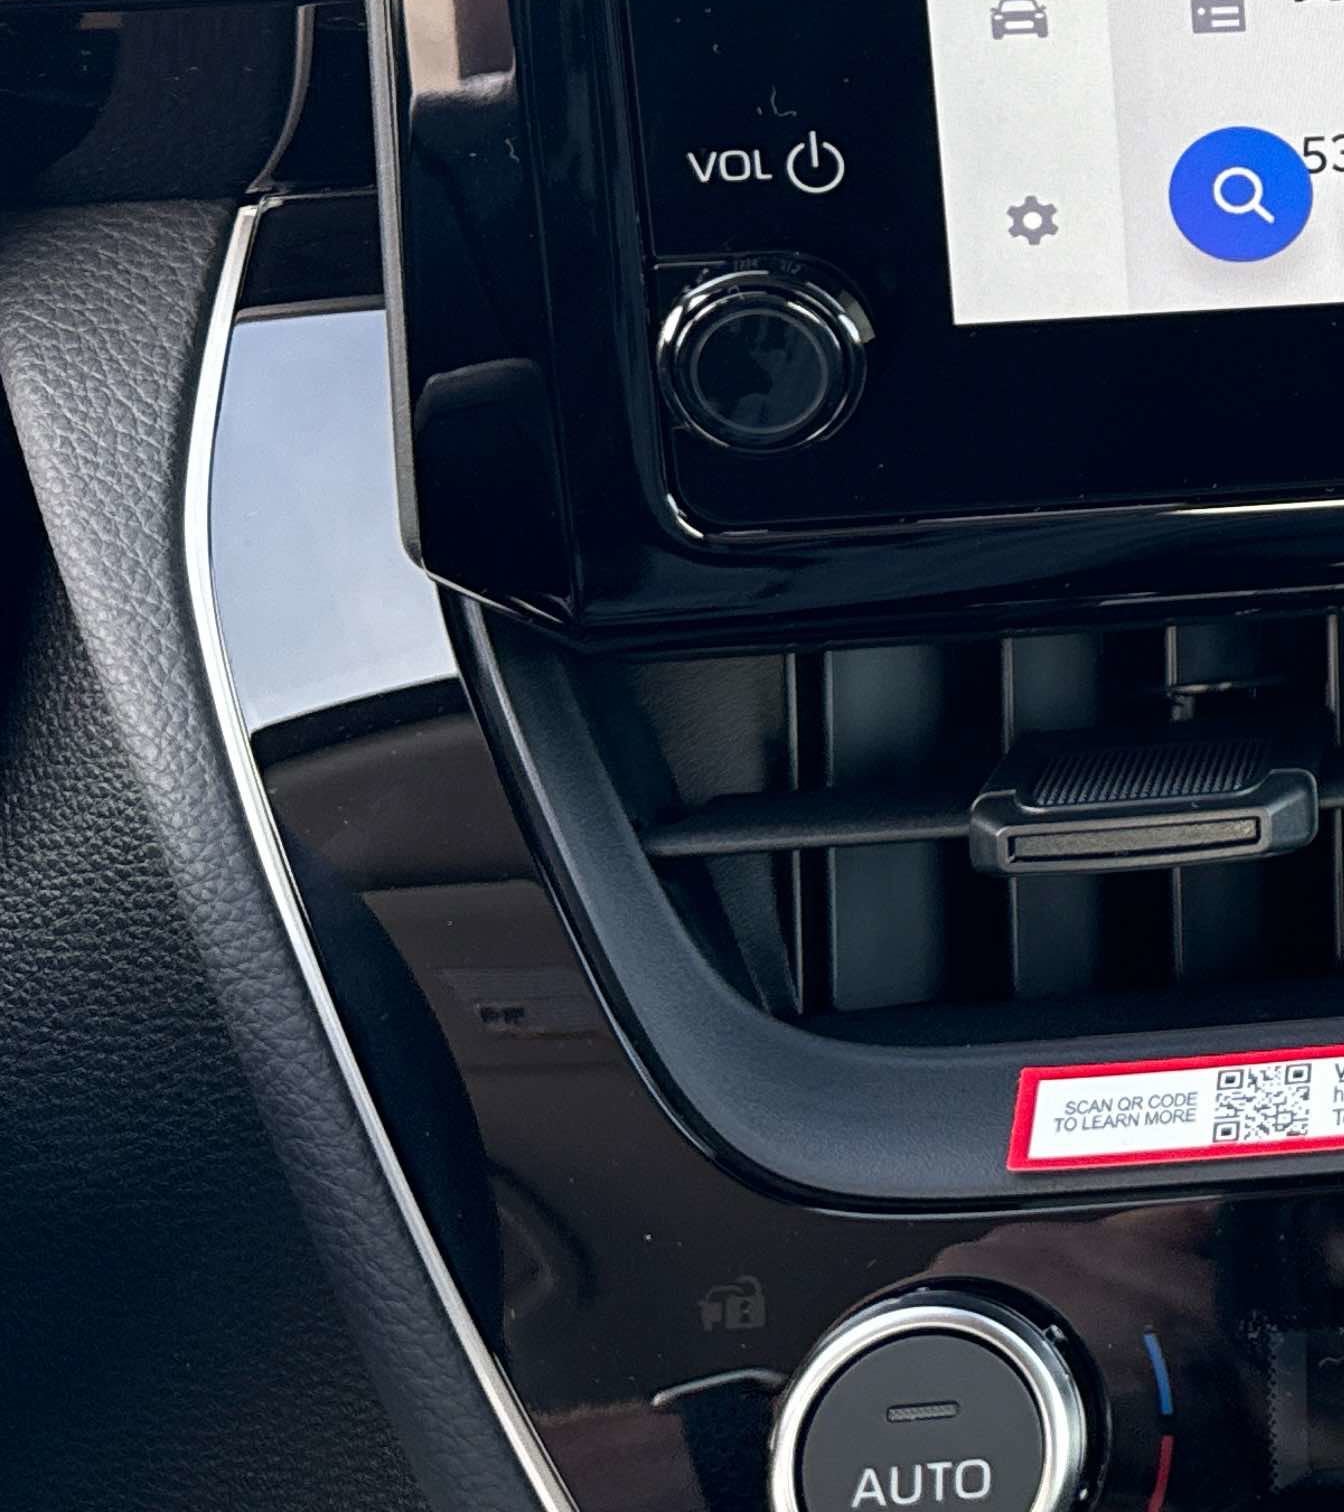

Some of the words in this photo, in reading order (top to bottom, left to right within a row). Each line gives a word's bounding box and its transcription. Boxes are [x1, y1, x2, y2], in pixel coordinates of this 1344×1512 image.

[686, 149, 773, 183] VOL
[1065, 1097, 1114, 1116] SCAN
[1148, 1091, 1199, 1109] CODE
[1054, 1117, 1078, 1133] TO
[1082, 1112, 1140, 1130] LEARN
[1144, 1108, 1197, 1125] MORE
[851, 1457, 992, 1509] AUTO
